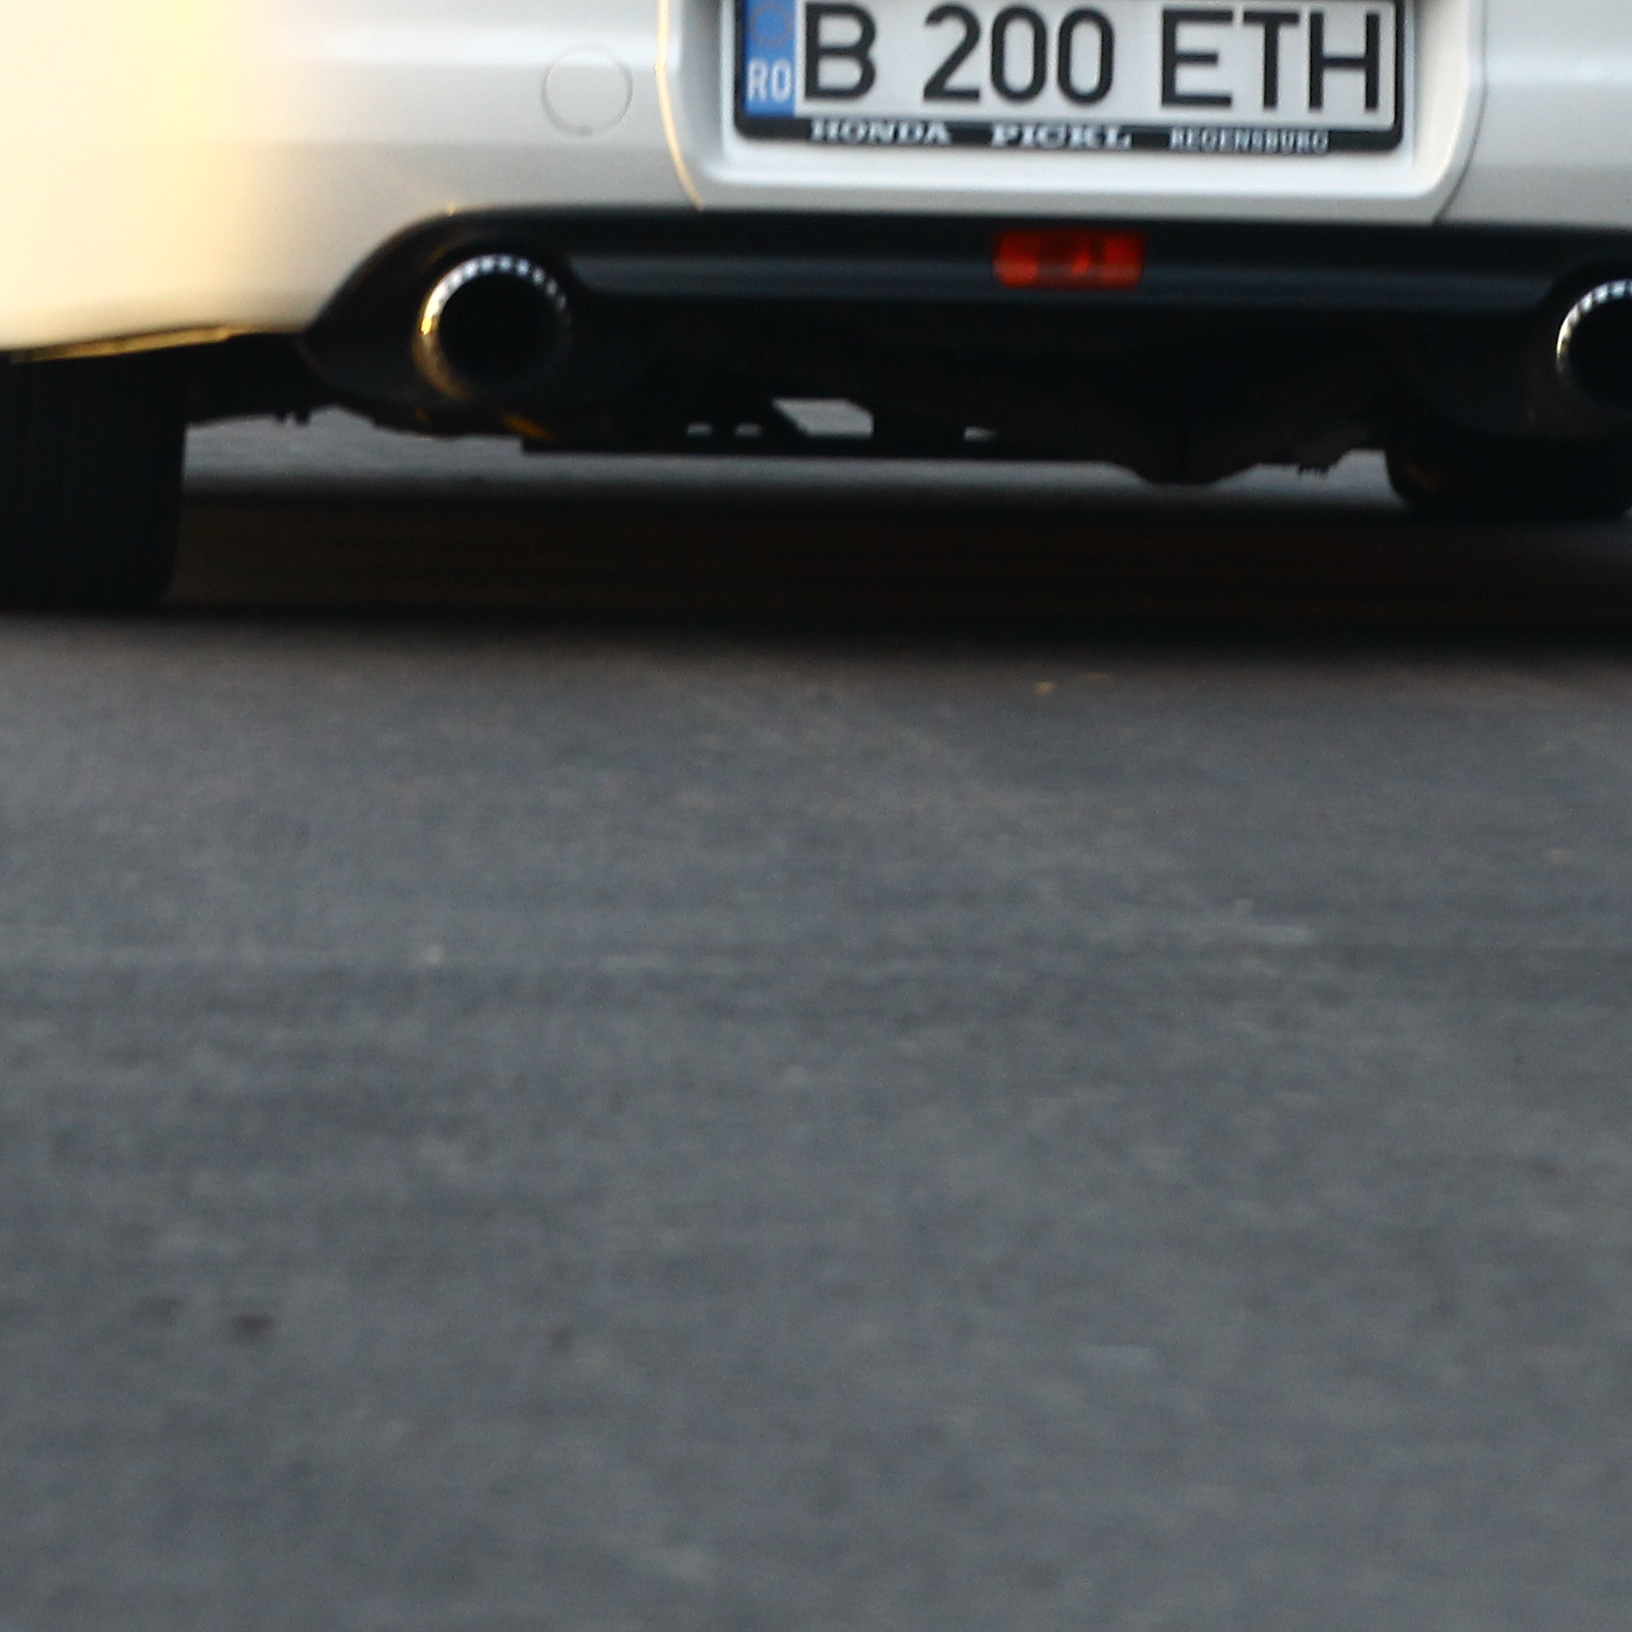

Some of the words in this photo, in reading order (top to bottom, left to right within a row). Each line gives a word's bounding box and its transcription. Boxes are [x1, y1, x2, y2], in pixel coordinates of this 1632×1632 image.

[804, 2, 877, 100] B
[923, 2, 1115, 106] 200
[1161, 8, 1381, 112] ETH
[746, 59, 793, 103] RO
[811, 118, 953, 145] HONDA
[1170, 126, 1330, 155] REGENSBURG
